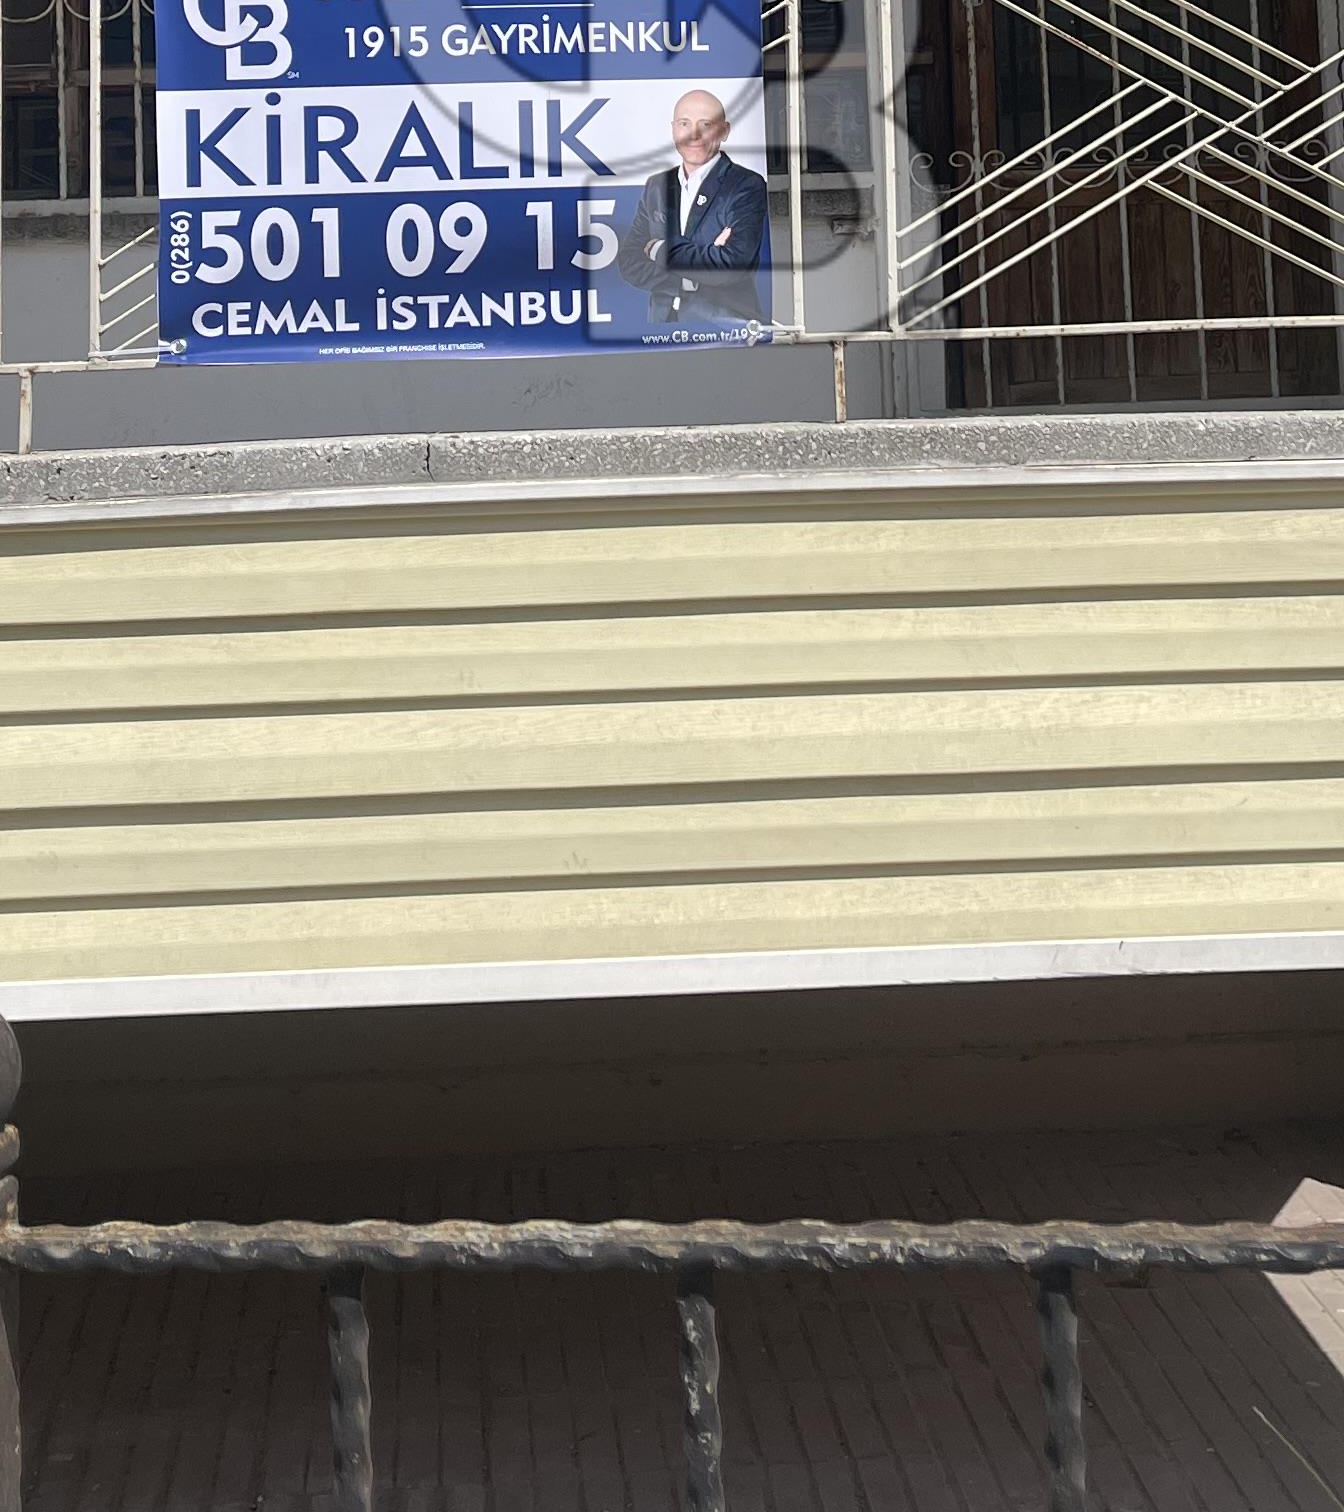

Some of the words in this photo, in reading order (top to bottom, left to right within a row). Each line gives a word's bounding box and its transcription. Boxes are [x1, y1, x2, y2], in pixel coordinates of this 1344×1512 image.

[344, 25, 429, 58] 1915
[441, 13, 710, 56] GAYRİMENKUL
[170, 210, 193, 284] 0(286)
[194, 207, 341, 284] 501
[385, 201, 488, 278] 09
[525, 199, 619, 271] 15
[191, 299, 360, 338] CEMAL
[376, 288, 612, 331] İSTANBUL
